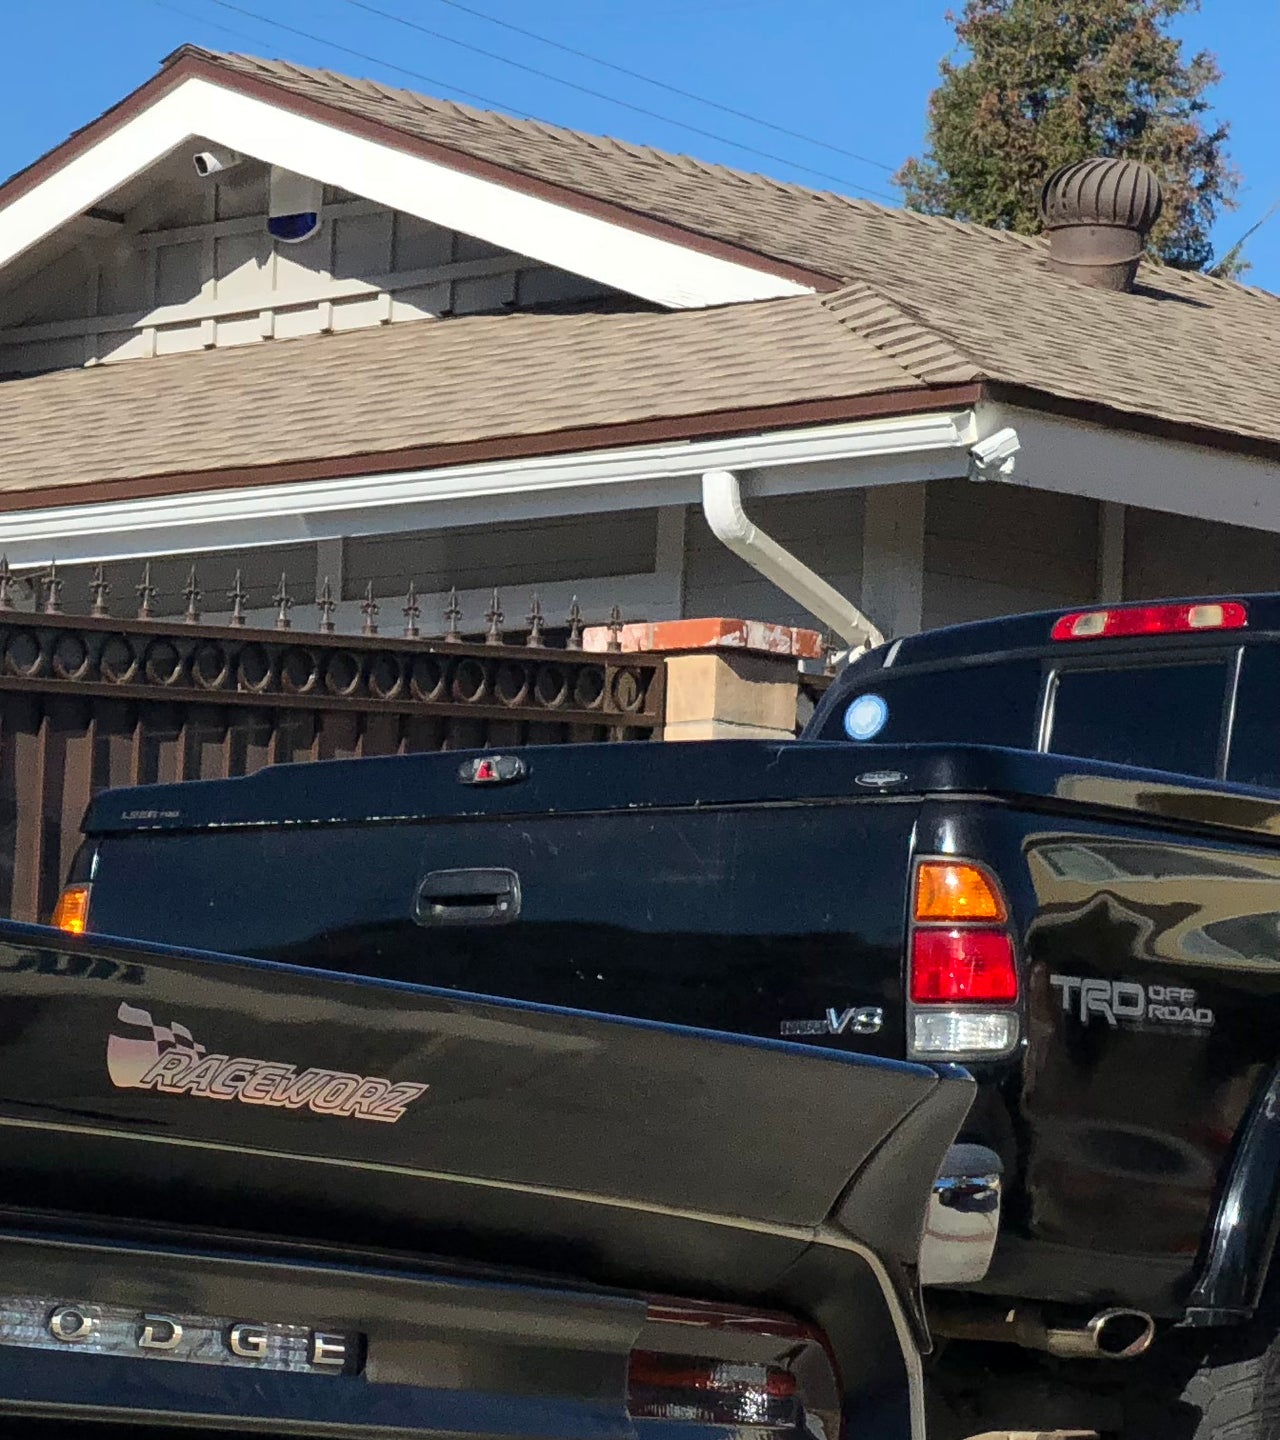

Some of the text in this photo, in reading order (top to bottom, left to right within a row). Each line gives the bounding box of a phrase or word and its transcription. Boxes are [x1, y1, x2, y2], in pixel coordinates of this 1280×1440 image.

[1050, 974, 1145, 1025] TRD
[1148, 985, 1197, 1001] OFF
[1148, 1004, 1214, 1024] ROAD
[139, 1048, 430, 1122] RACEWORZ
